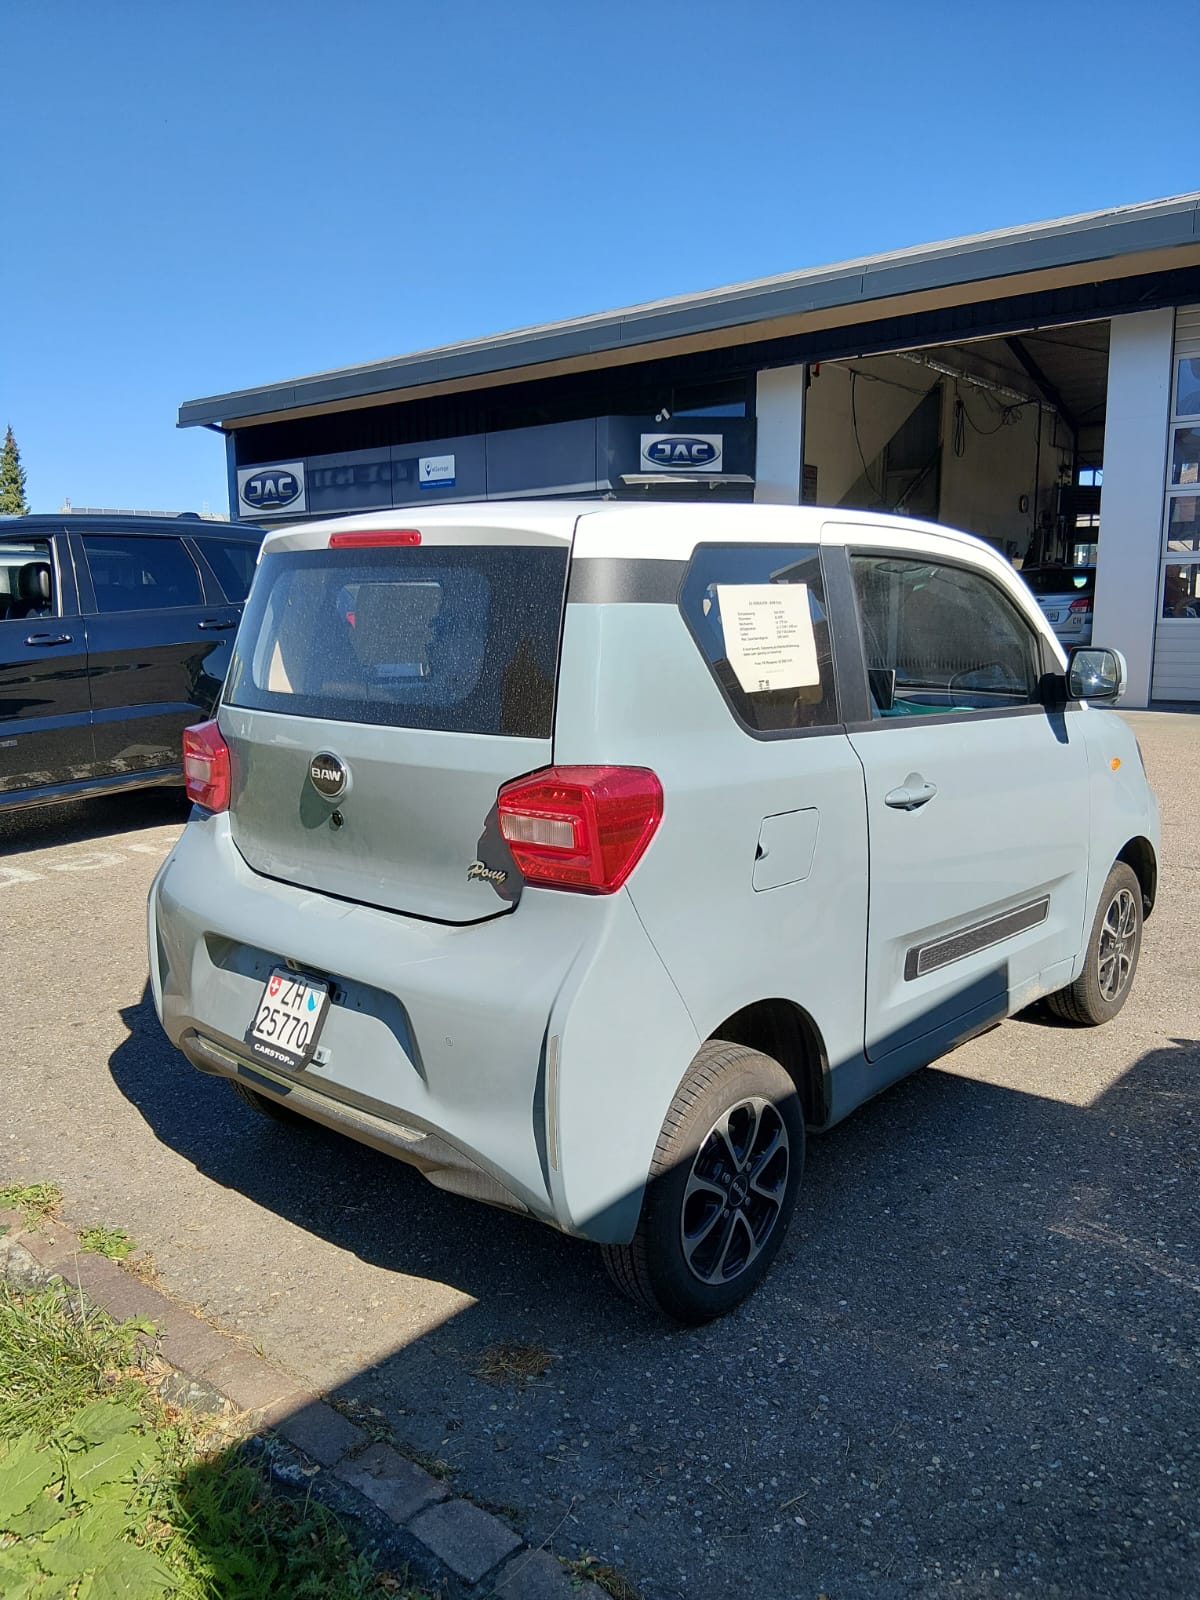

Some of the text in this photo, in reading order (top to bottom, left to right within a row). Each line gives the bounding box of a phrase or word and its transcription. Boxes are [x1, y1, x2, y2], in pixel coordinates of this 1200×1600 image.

[655, 444, 708, 459] JAC
[250, 476, 293, 498] JAC
[311, 767, 341, 782] BAW
[467, 861, 506, 885] Pony
[281, 976, 308, 1010] ZH
[256, 1006, 309, 1049] 25770
